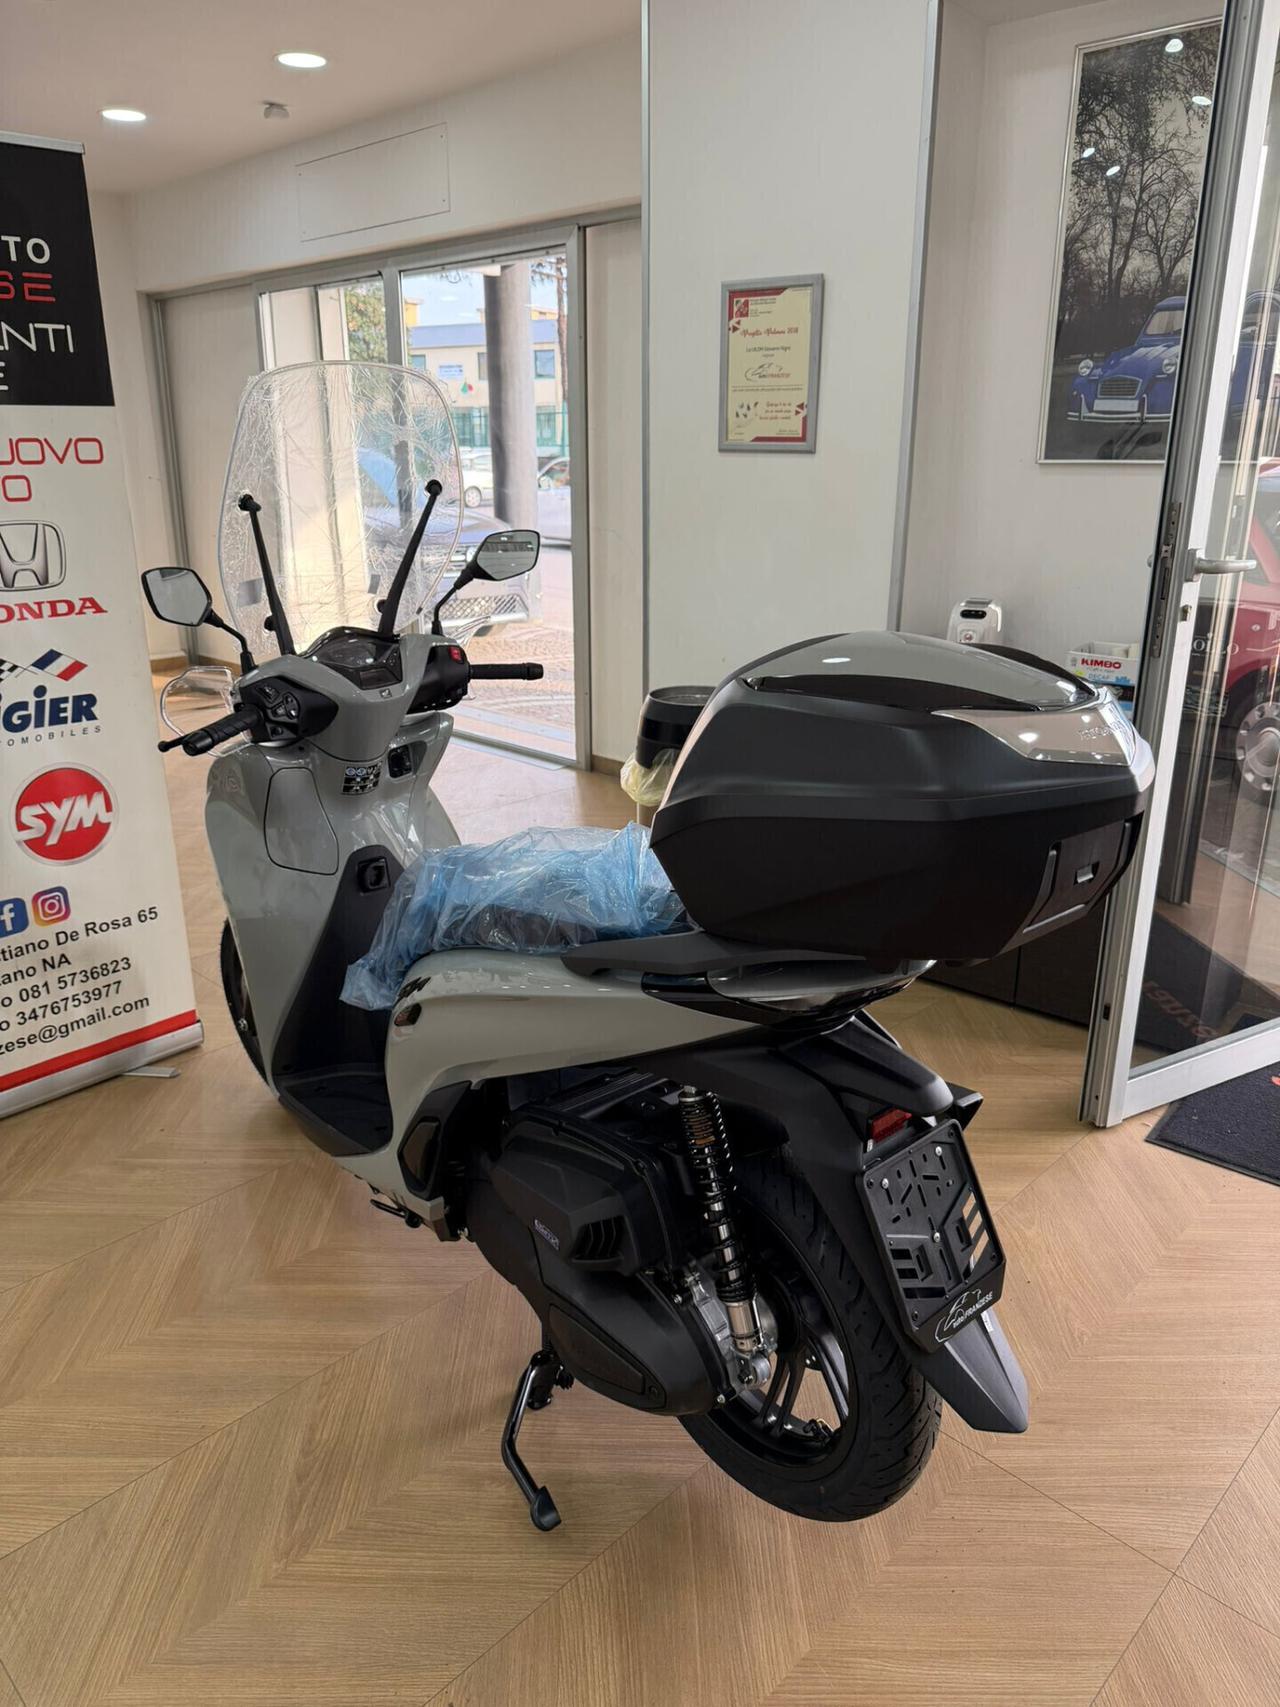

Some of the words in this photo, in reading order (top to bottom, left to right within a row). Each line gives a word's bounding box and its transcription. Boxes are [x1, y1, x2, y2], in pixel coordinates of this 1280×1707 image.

[1, 235, 51, 265] TO
[0, 321, 75, 353] NTI
[1081, 658, 1122, 670] KIMBO
[0, 725, 101, 747] OMOBILES
[16, 791, 112, 846] SYM
[0, 938, 49, 964] tiano
[55, 930, 80, 947] De
[84, 915, 133, 937] Rosa
[137, 906, 158, 924] 65
[0, 965, 37, 987] ano
[42, 953, 72, 972] NA
[19, 981, 51, 1003] 081
[57, 956, 132, 990] 5736823
[16, 980, 122, 1026] 3476753977
